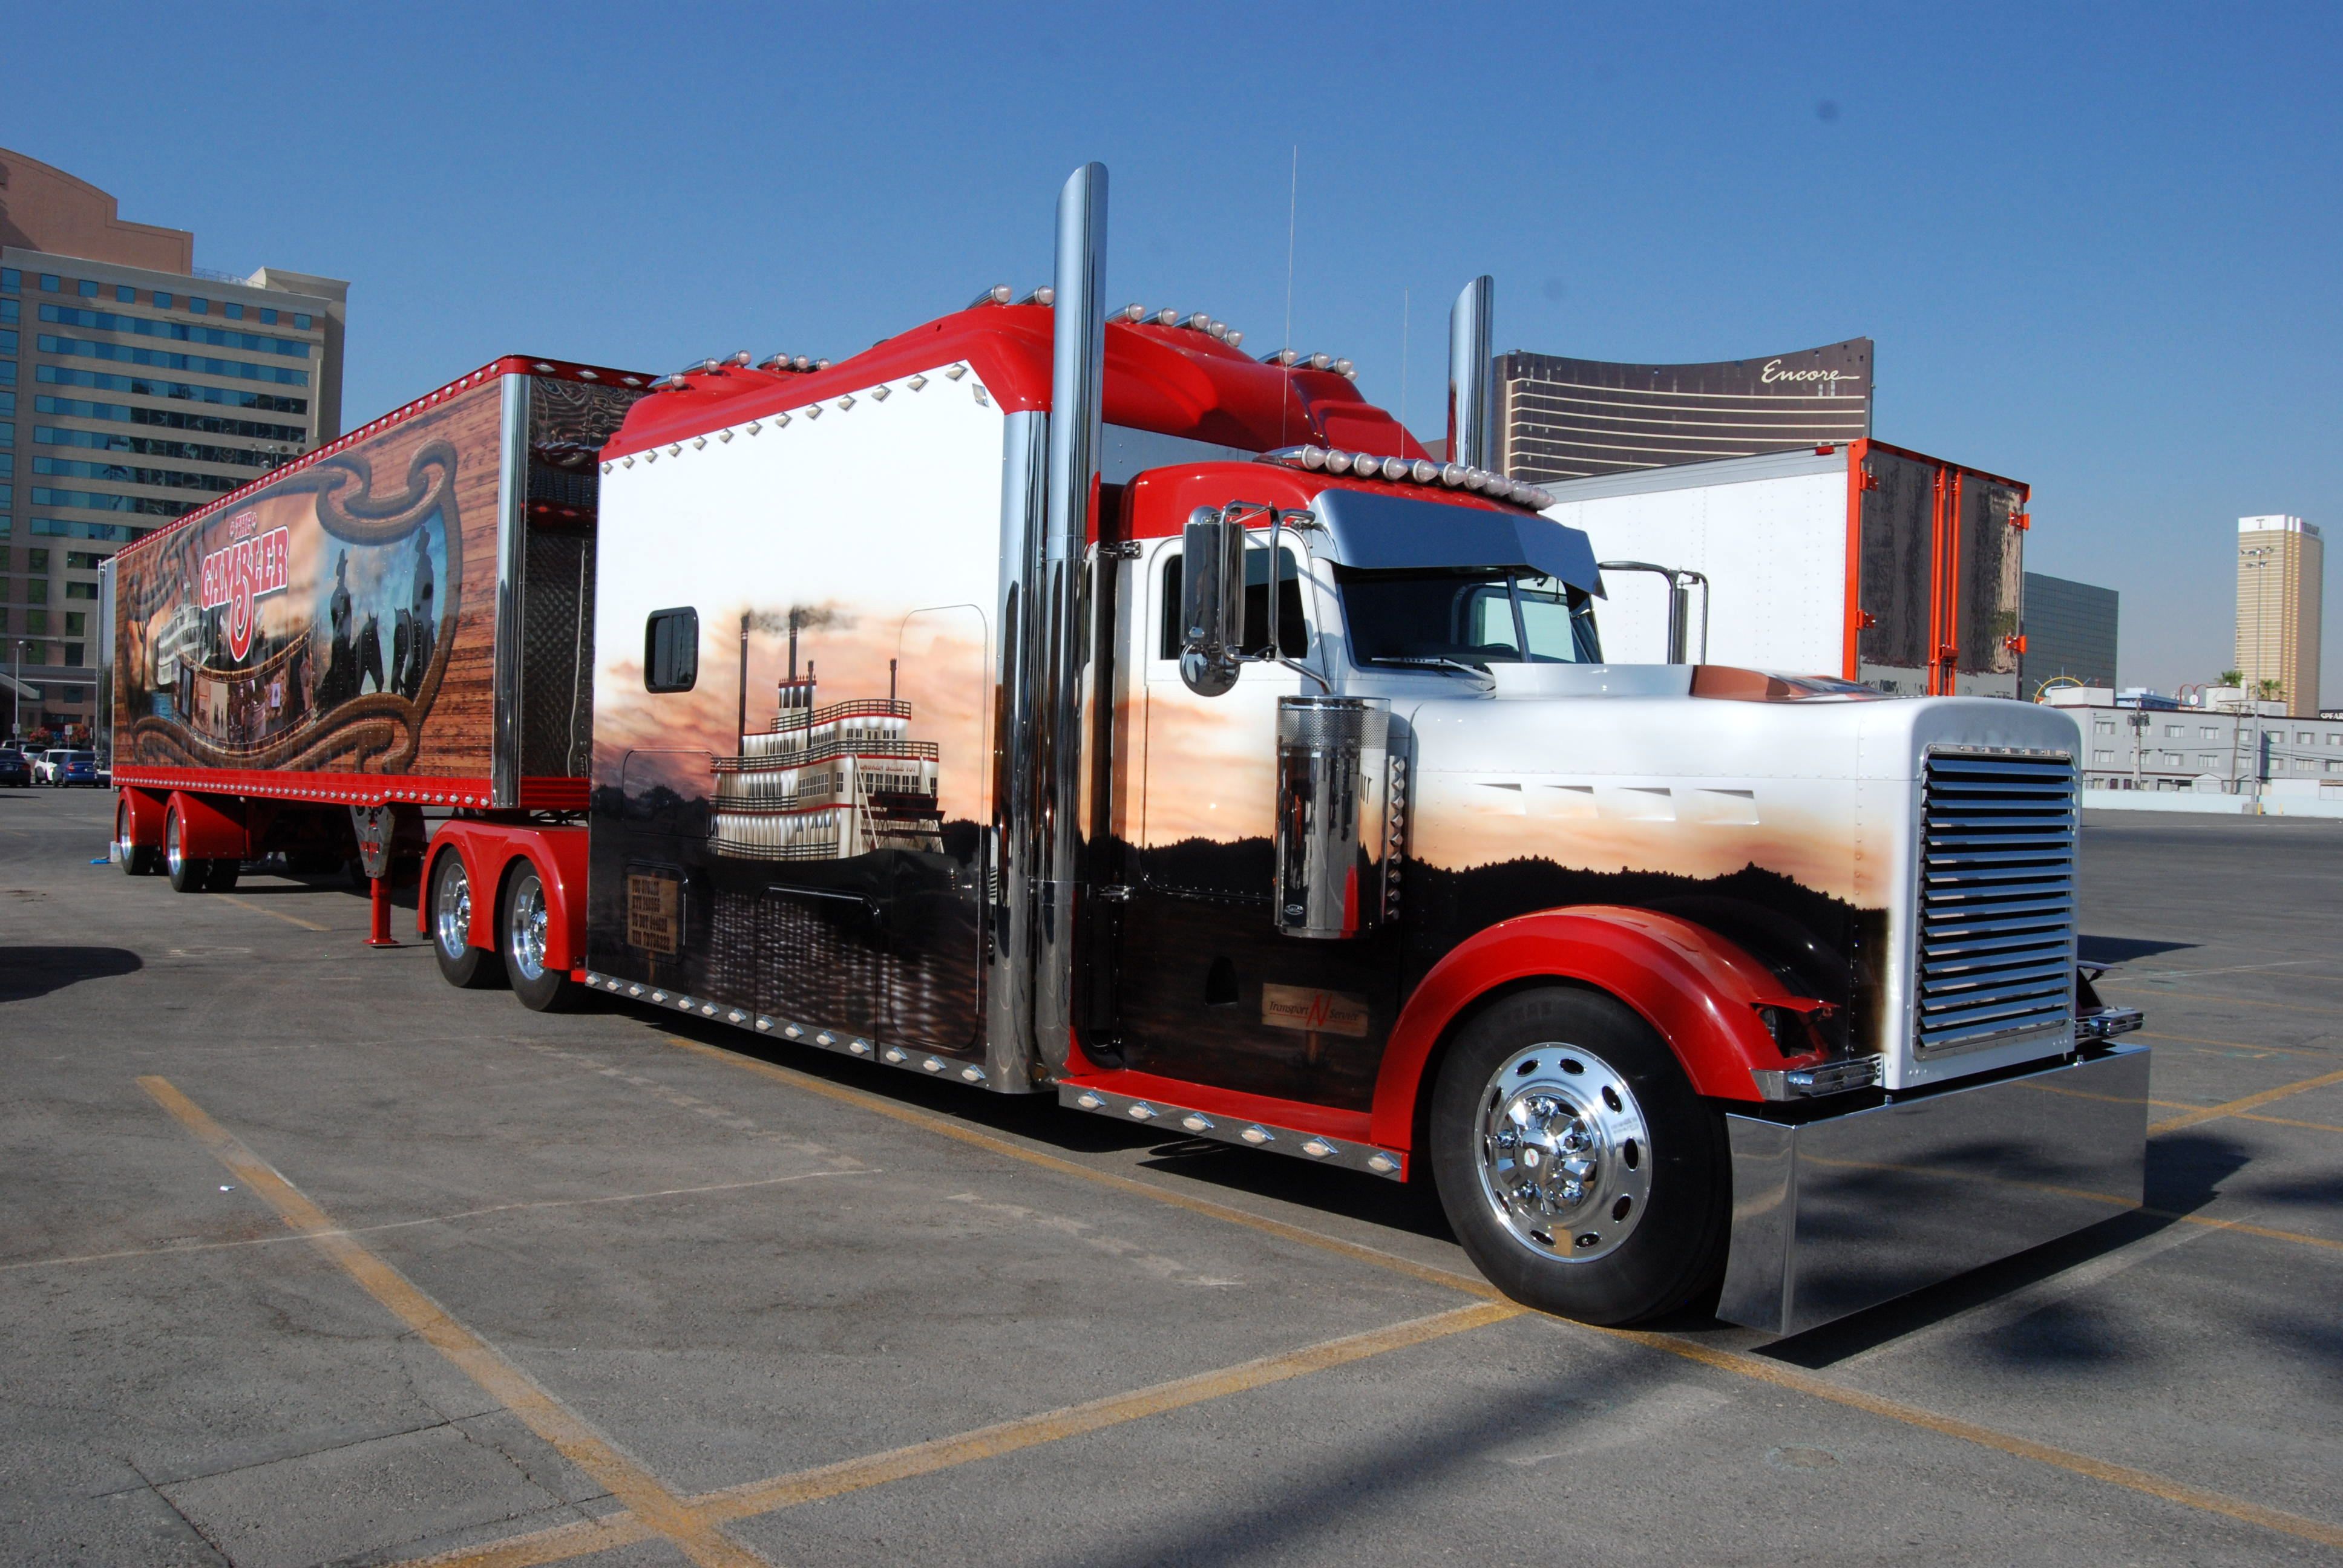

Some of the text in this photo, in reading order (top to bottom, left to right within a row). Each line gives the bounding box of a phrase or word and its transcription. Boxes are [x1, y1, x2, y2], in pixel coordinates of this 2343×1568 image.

[1761, 359, 1860, 384] Encore
[235, 512, 252, 539] THE
[2256, 518, 2265, 529] T
[200, 526, 289, 662] GAMBLER
[1269, 993, 1359, 1027] Transport N Service
